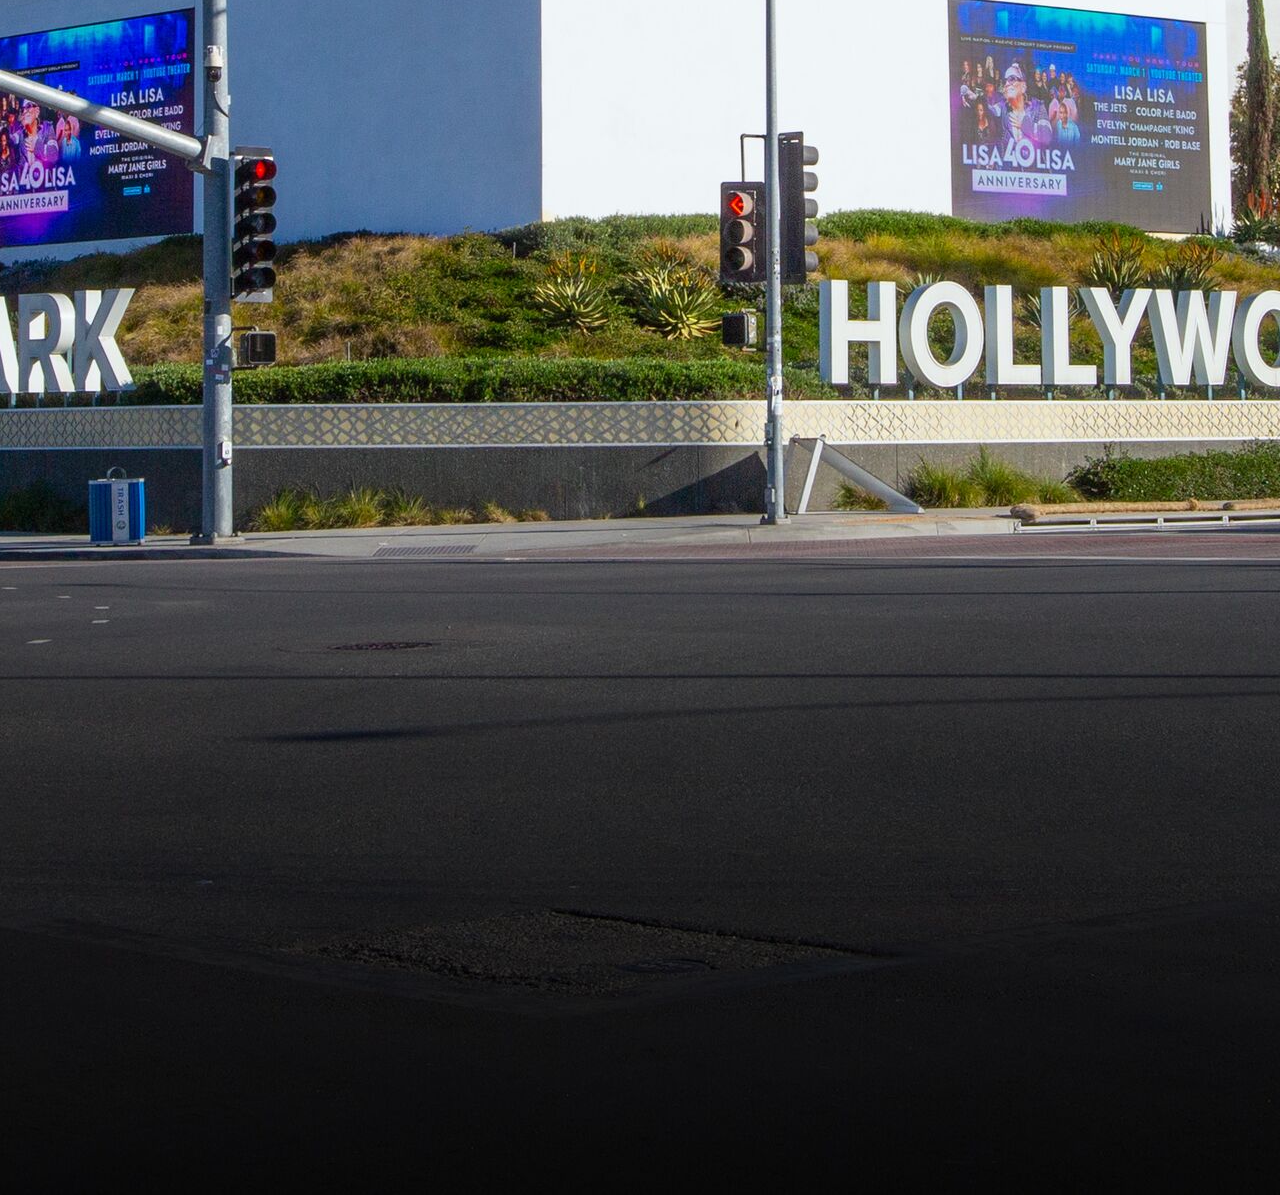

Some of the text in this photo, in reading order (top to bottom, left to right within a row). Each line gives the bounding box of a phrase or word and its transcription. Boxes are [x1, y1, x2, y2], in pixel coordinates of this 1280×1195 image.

[1175, 60, 1200, 68] TOUR
[116, 70, 132, 82] MARCH
[144, 66, 166, 78] YOUTUBE
[167, 63, 190, 76] THEATER
[1120, 65, 1141, 78] MARCH
[1150, 69, 1176, 80] YOUTUBE
[1177, 71, 1203, 83] THEATER
[111, 87, 164, 107] LISA LISA
[1114, 85, 1175, 104] LISA LISA
[153, 107, 163, 117] ME
[164, 105, 184, 116] BADD
[1093, 102, 1197, 120] THE JETS COLOR ME BADD
[1130, 123, 1172, 134] CHAMPAGNE
[89, 141, 148, 156] MONTELL JORDAN
[1091, 135, 1200, 151] MONTELL JORDAN ROB BASE
[962, 138, 1076, 171] LISA 40 LISA
[108, 159, 167, 174] MARY JANE GIRLS
[1114, 157, 1180, 170] MARY JANE GIRLS
[20, 161, 44, 190] 40
[45, 165, 76, 188] LISA
[978, 175, 1062, 190] ANNIVERSARY
[0, 195, 65, 211] ANNIVERSARY
[117, 487, 125, 516] TRASH
